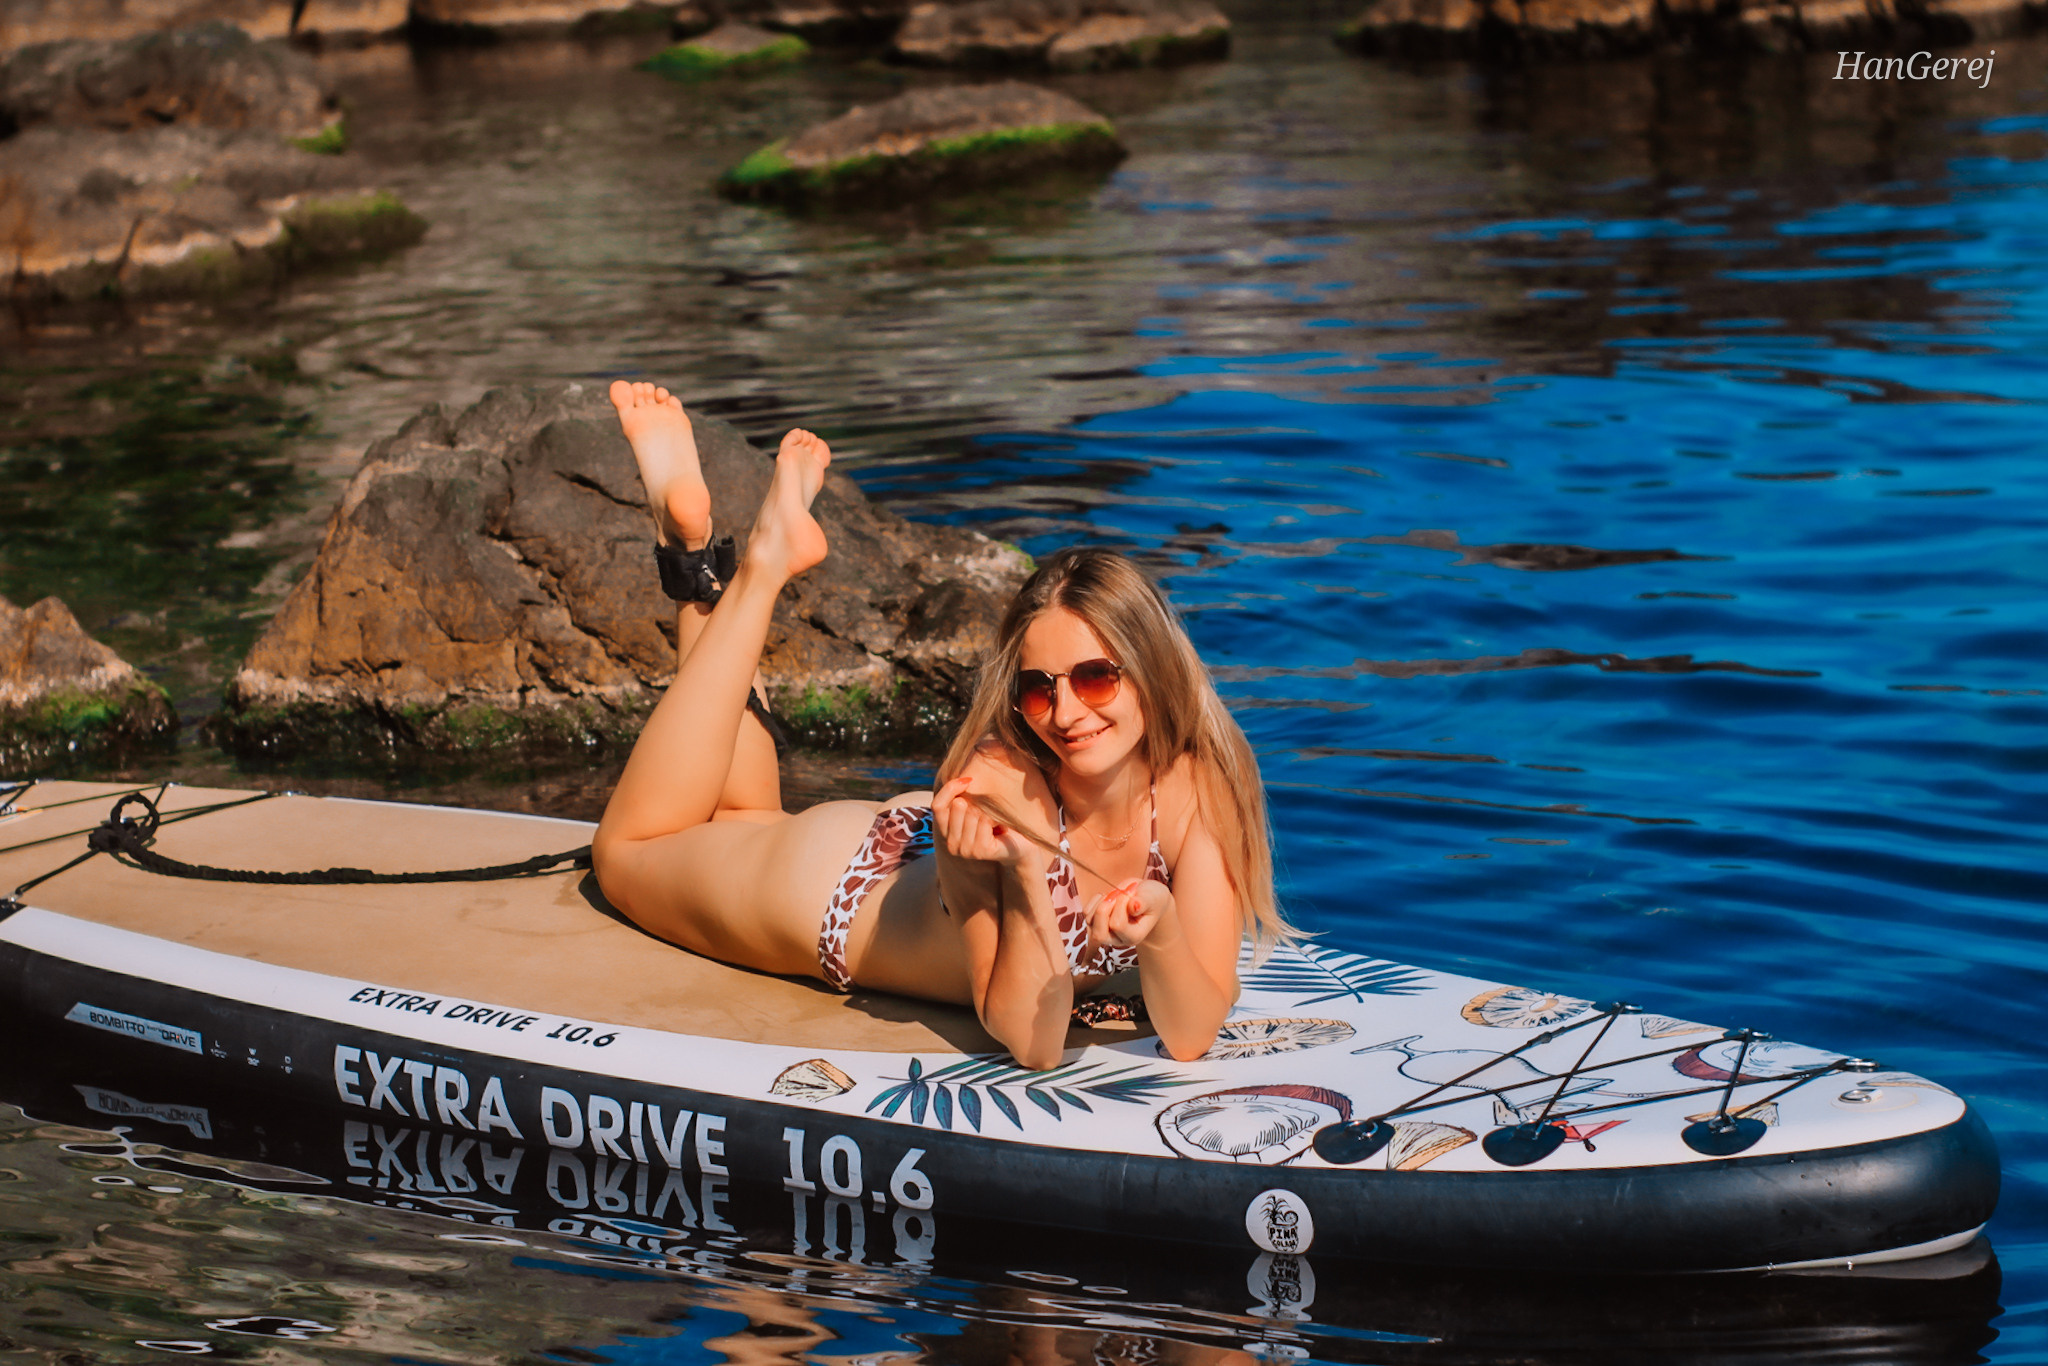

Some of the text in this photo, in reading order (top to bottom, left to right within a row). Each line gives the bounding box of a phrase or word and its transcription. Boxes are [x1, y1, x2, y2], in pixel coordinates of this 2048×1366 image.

[89, 1011, 145, 1035] BOMBITTO
[349, 987, 621, 1048] EXTRA DRIVE 10.6
[334, 1043, 935, 1211] EXTRA DRIVE 10.6
